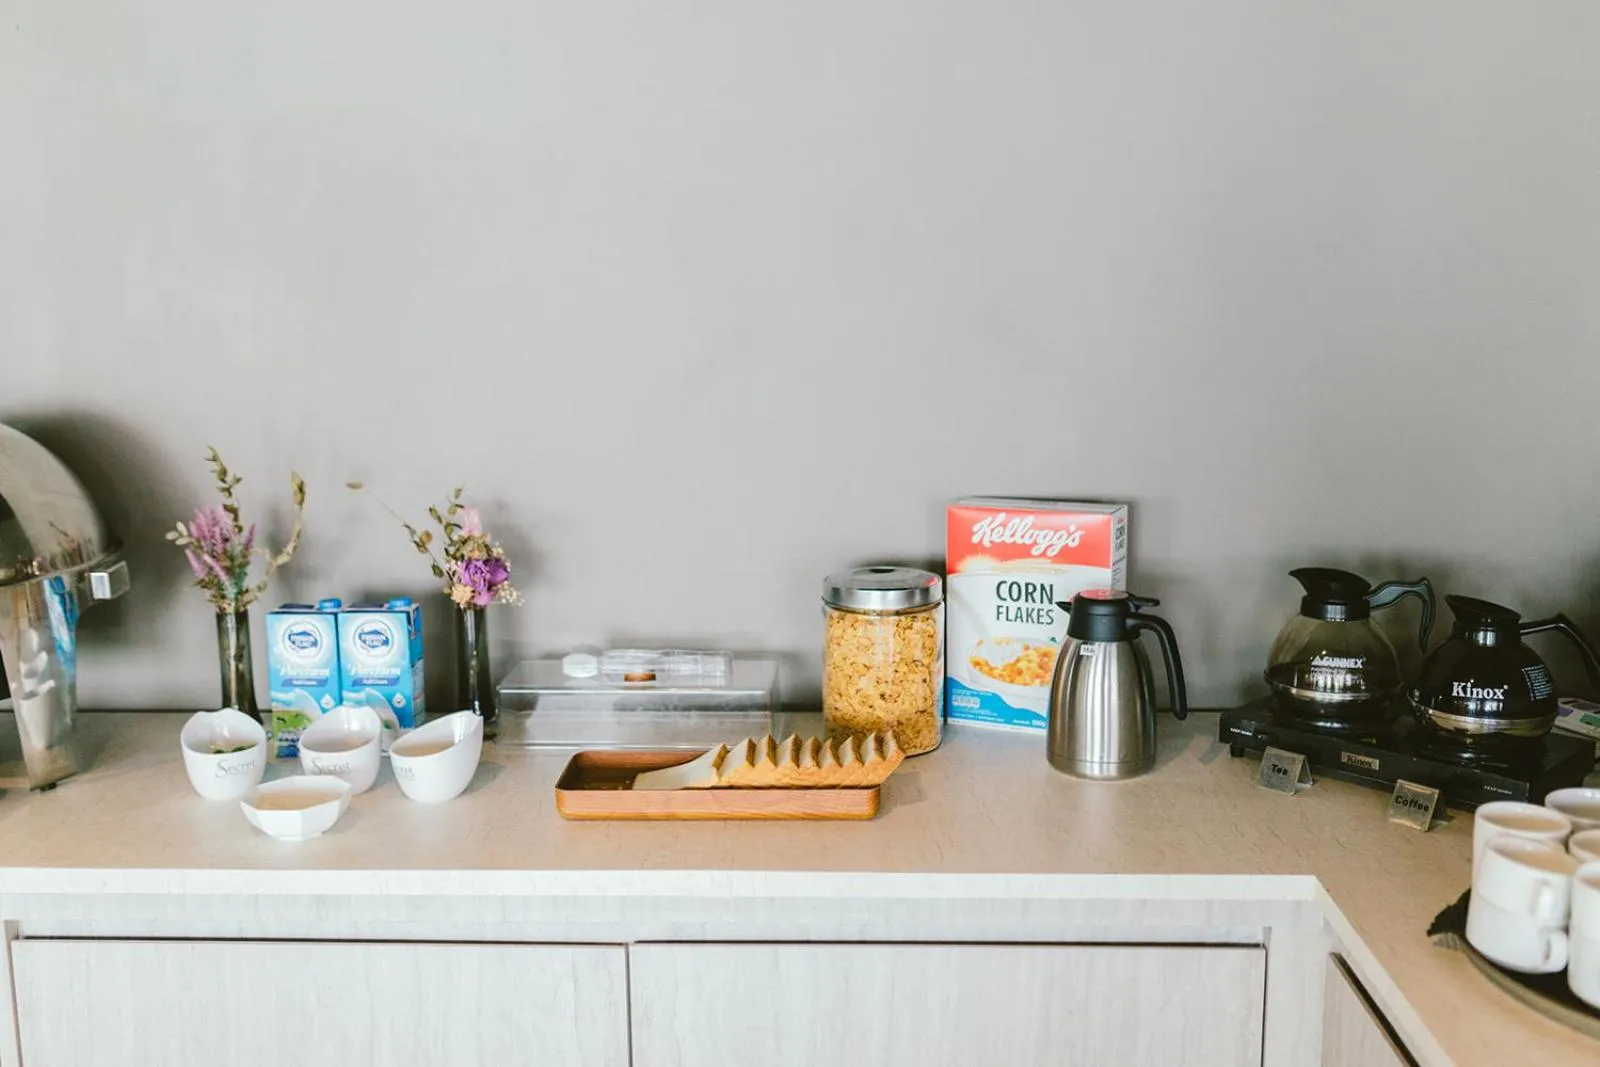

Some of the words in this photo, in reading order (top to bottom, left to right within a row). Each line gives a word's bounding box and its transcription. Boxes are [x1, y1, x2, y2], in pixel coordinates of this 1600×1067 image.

[971, 513, 1084, 557] Kellogg's
[996, 580, 1054, 605] CORN
[996, 605, 1055, 626] FLAKES
[1452, 680, 1505, 700] Kinox
[1271, 763, 1288, 776] Tea
[1395, 794, 1430, 812] Coffee
